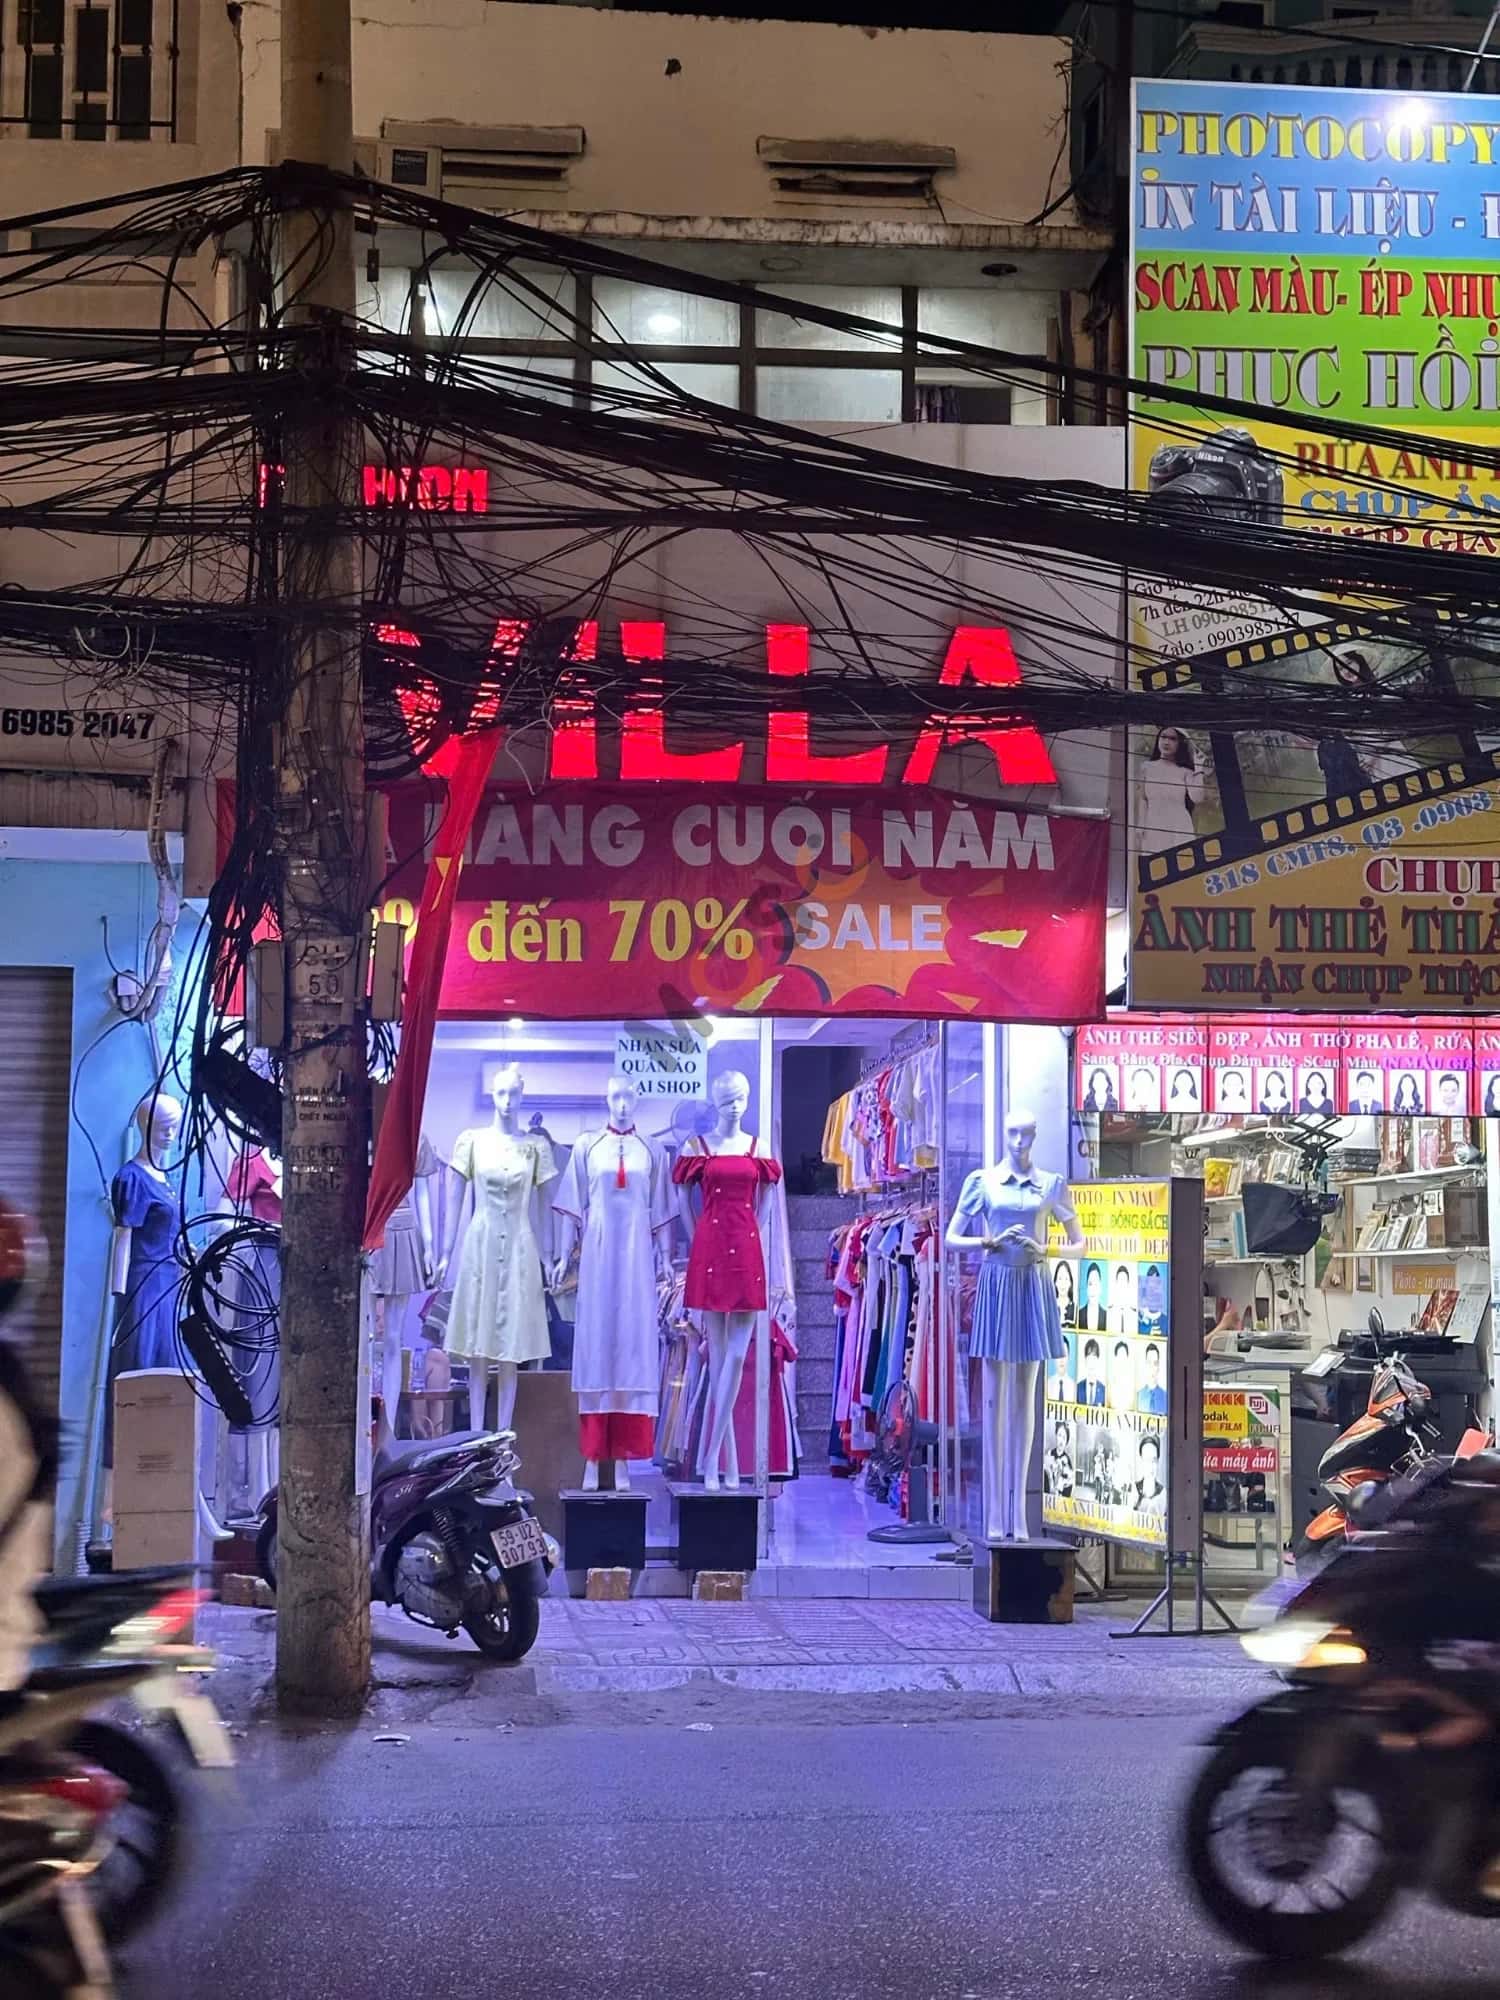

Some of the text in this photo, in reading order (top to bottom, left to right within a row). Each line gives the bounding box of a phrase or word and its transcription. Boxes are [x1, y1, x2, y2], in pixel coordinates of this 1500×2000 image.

[1137, 110, 1500, 165] PHOTOCOPY
[1210, 172, 1301, 233] TÀI
[1314, 177, 1440, 255] LIỆU
[1135, 260, 1242, 315] SCAN
[1359, 258, 1413, 319] ÉP
[1195, 452, 1224, 463] Nikon
[1161, 620, 1188, 637] LH
[2, 708, 156, 740] 6985 2047
[672, 790, 852, 867] CUỐI
[882, 800, 1056, 871] NĂM
[1205, 862, 1260, 896] 318
[467, 898, 583, 963] đến
[609, 897, 754, 962] 70%
[794, 902, 945, 952] SALE
[1311, 963, 1413, 1004] CHỤP
[1355, 1034, 1392, 1049] PHA
[657, 1080, 702, 1095] SHOP
[1219, 1423, 1243, 1431] FILM
[1222, 1453, 1249, 1473] máy
